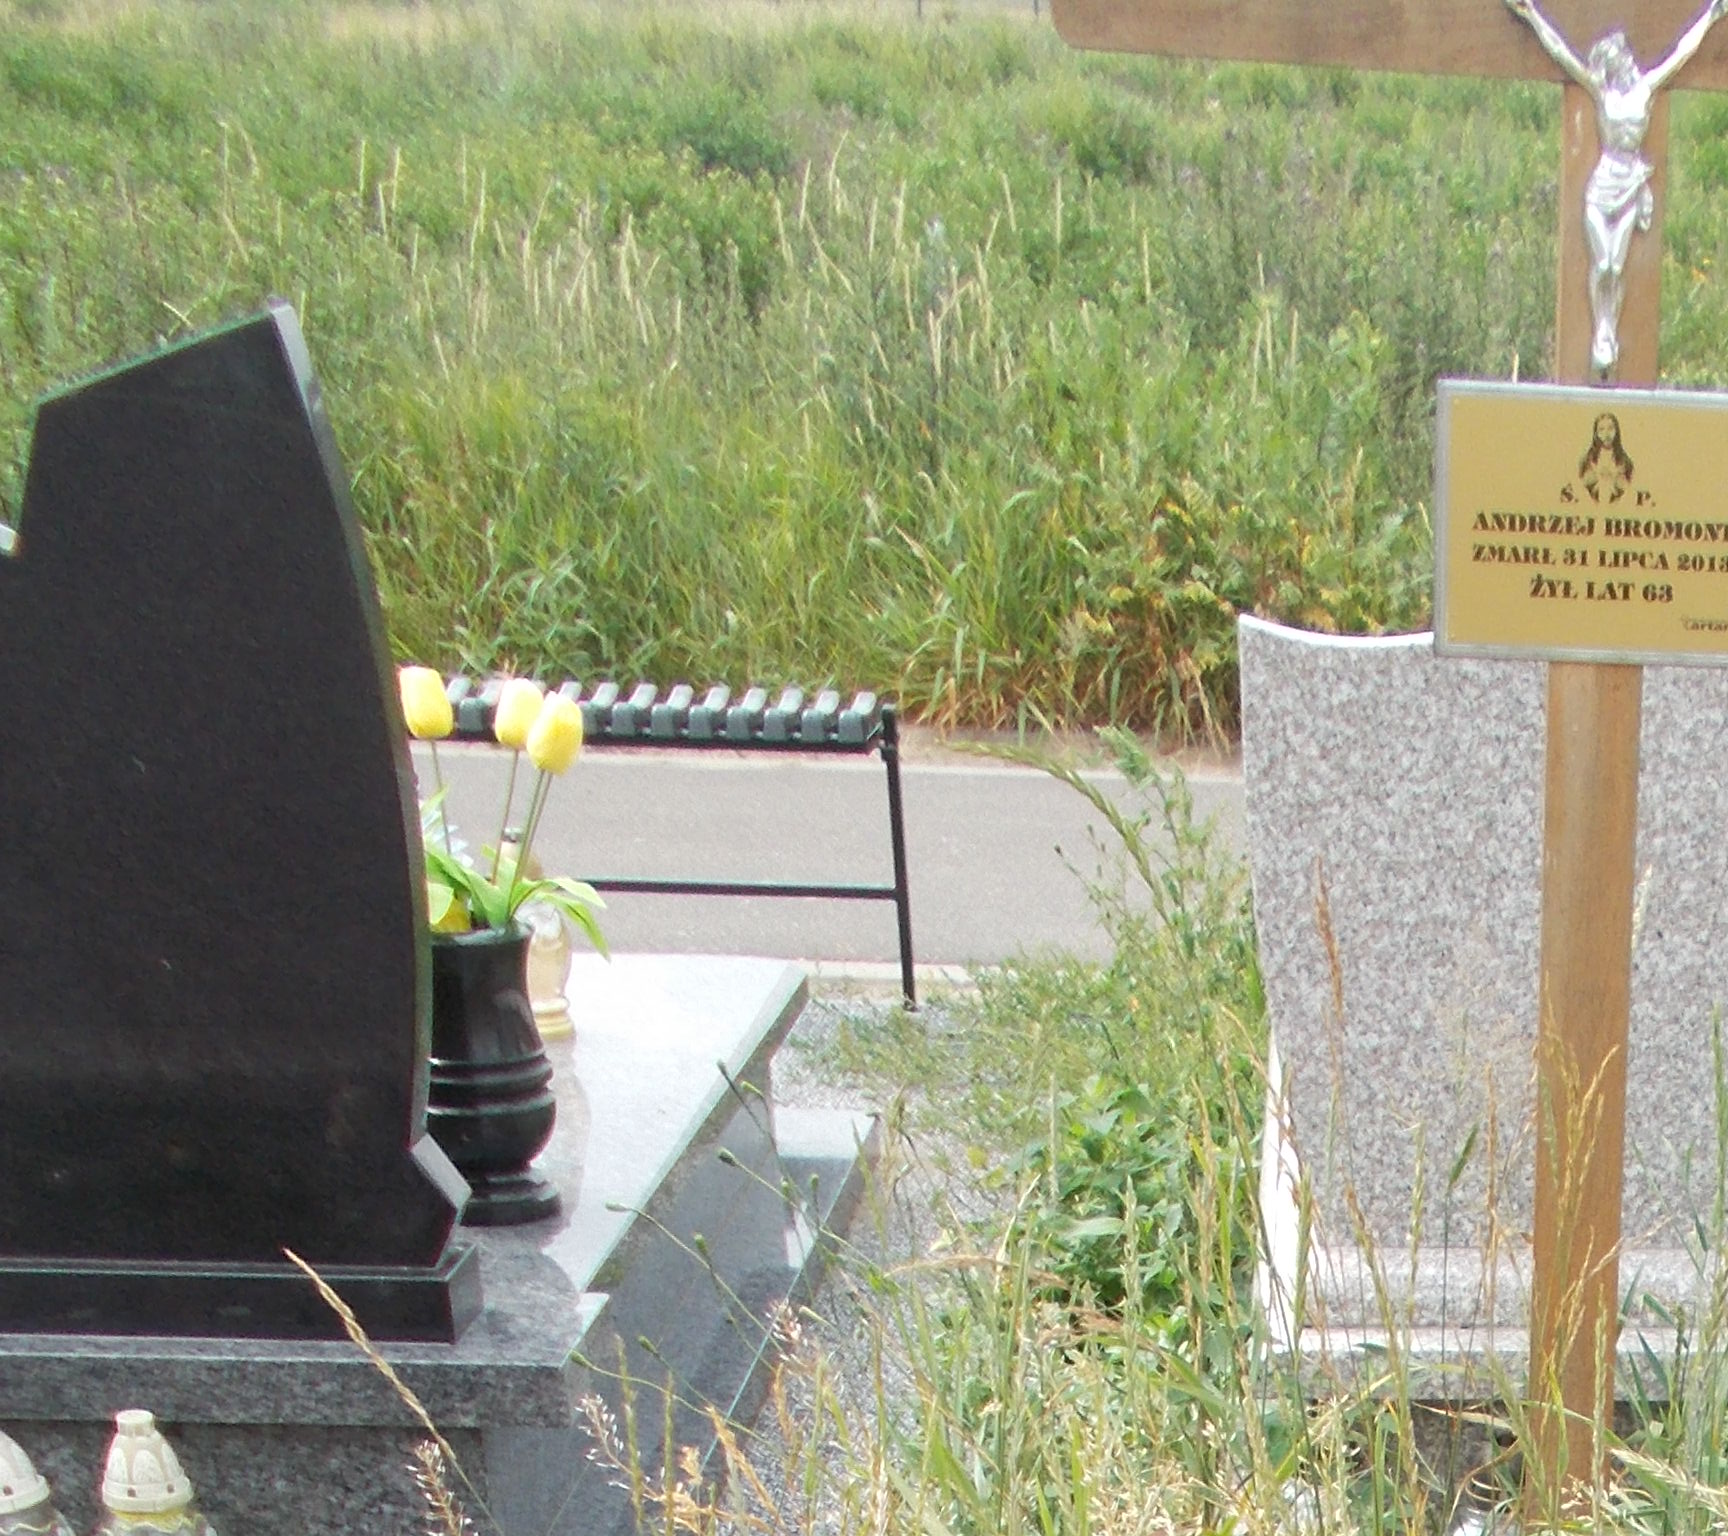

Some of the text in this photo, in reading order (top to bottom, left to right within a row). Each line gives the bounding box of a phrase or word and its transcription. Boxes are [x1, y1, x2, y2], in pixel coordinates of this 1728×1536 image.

[1636, 490, 1656, 507] P.
[1472, 511, 1595, 537] ANDRZEJ
[1563, 550, 1589, 567] 31
[1598, 551, 1670, 571] LIPCA
[1530, 574, 1674, 603] ŻYŁ LAT 63
